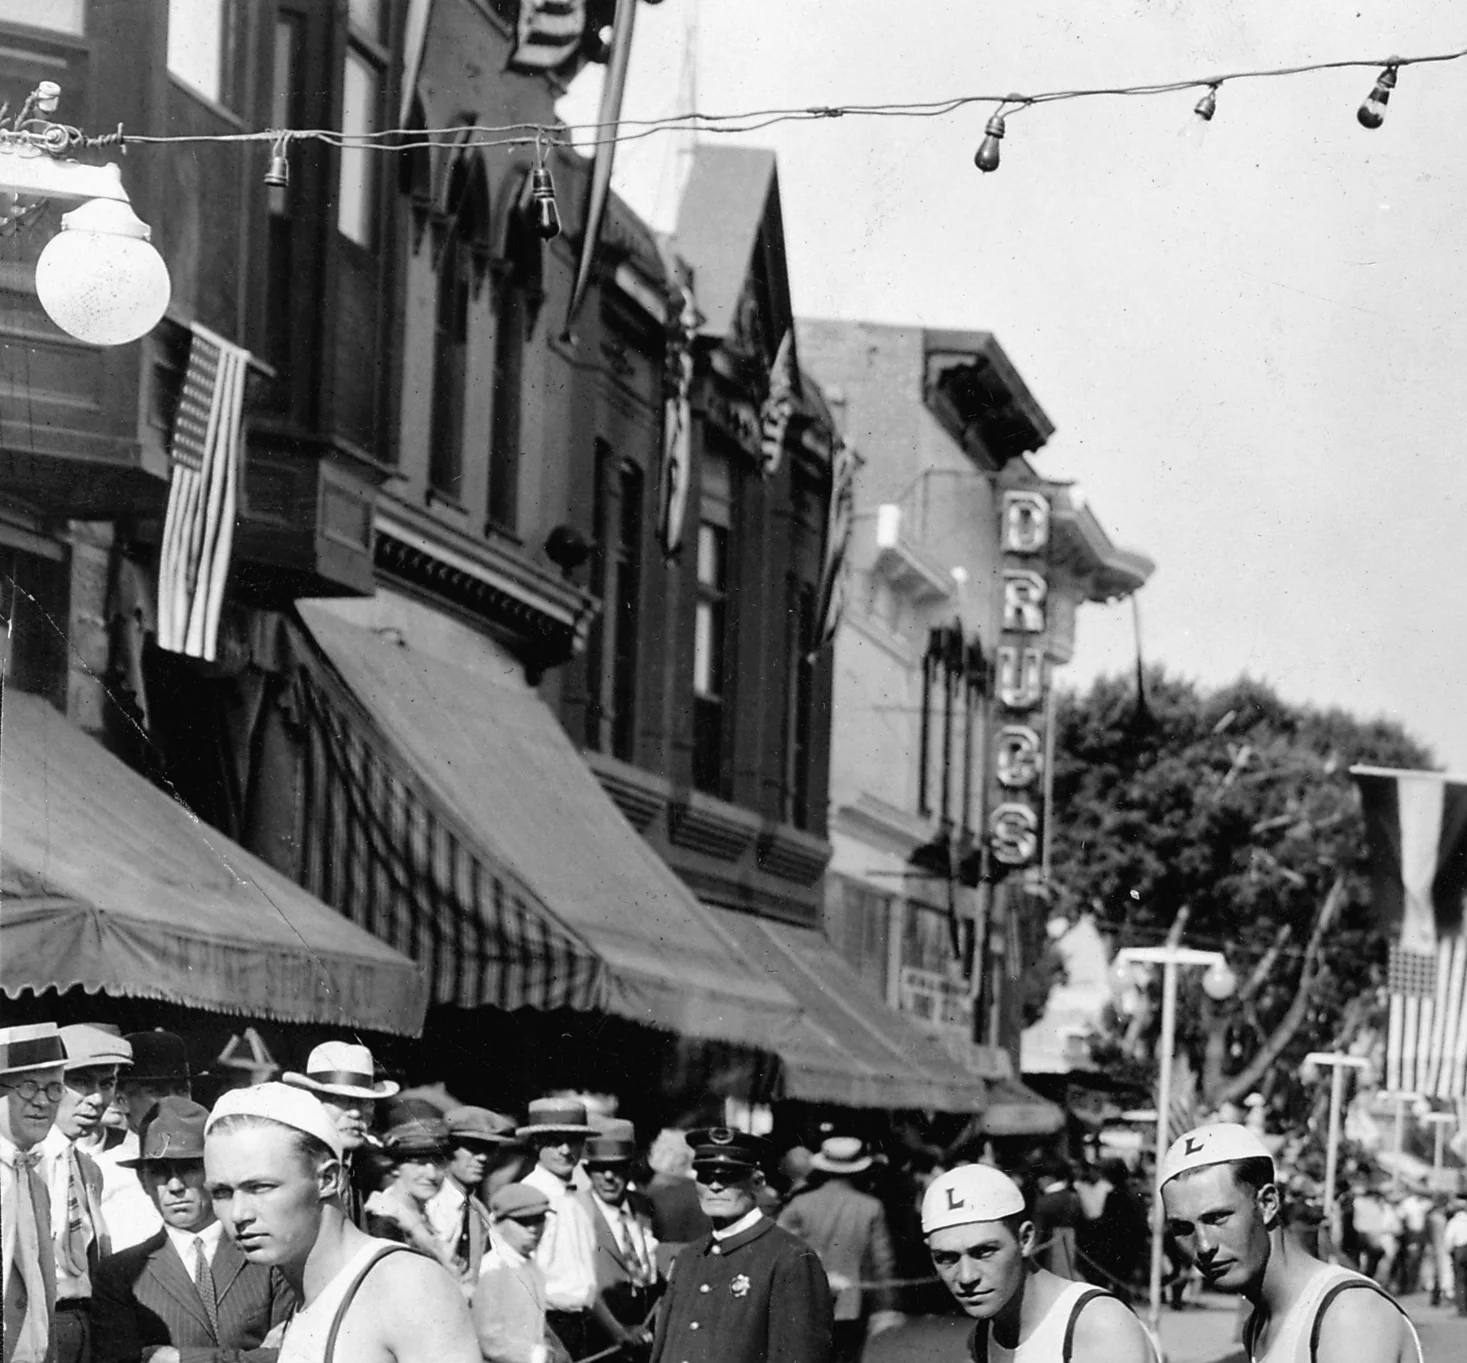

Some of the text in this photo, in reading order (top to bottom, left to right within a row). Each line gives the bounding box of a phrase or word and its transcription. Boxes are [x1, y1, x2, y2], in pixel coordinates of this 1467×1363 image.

[993, 491, 1050, 865] DRUGS
[1185, 1137, 1204, 1155] L
[946, 1188, 965, 1210] L
